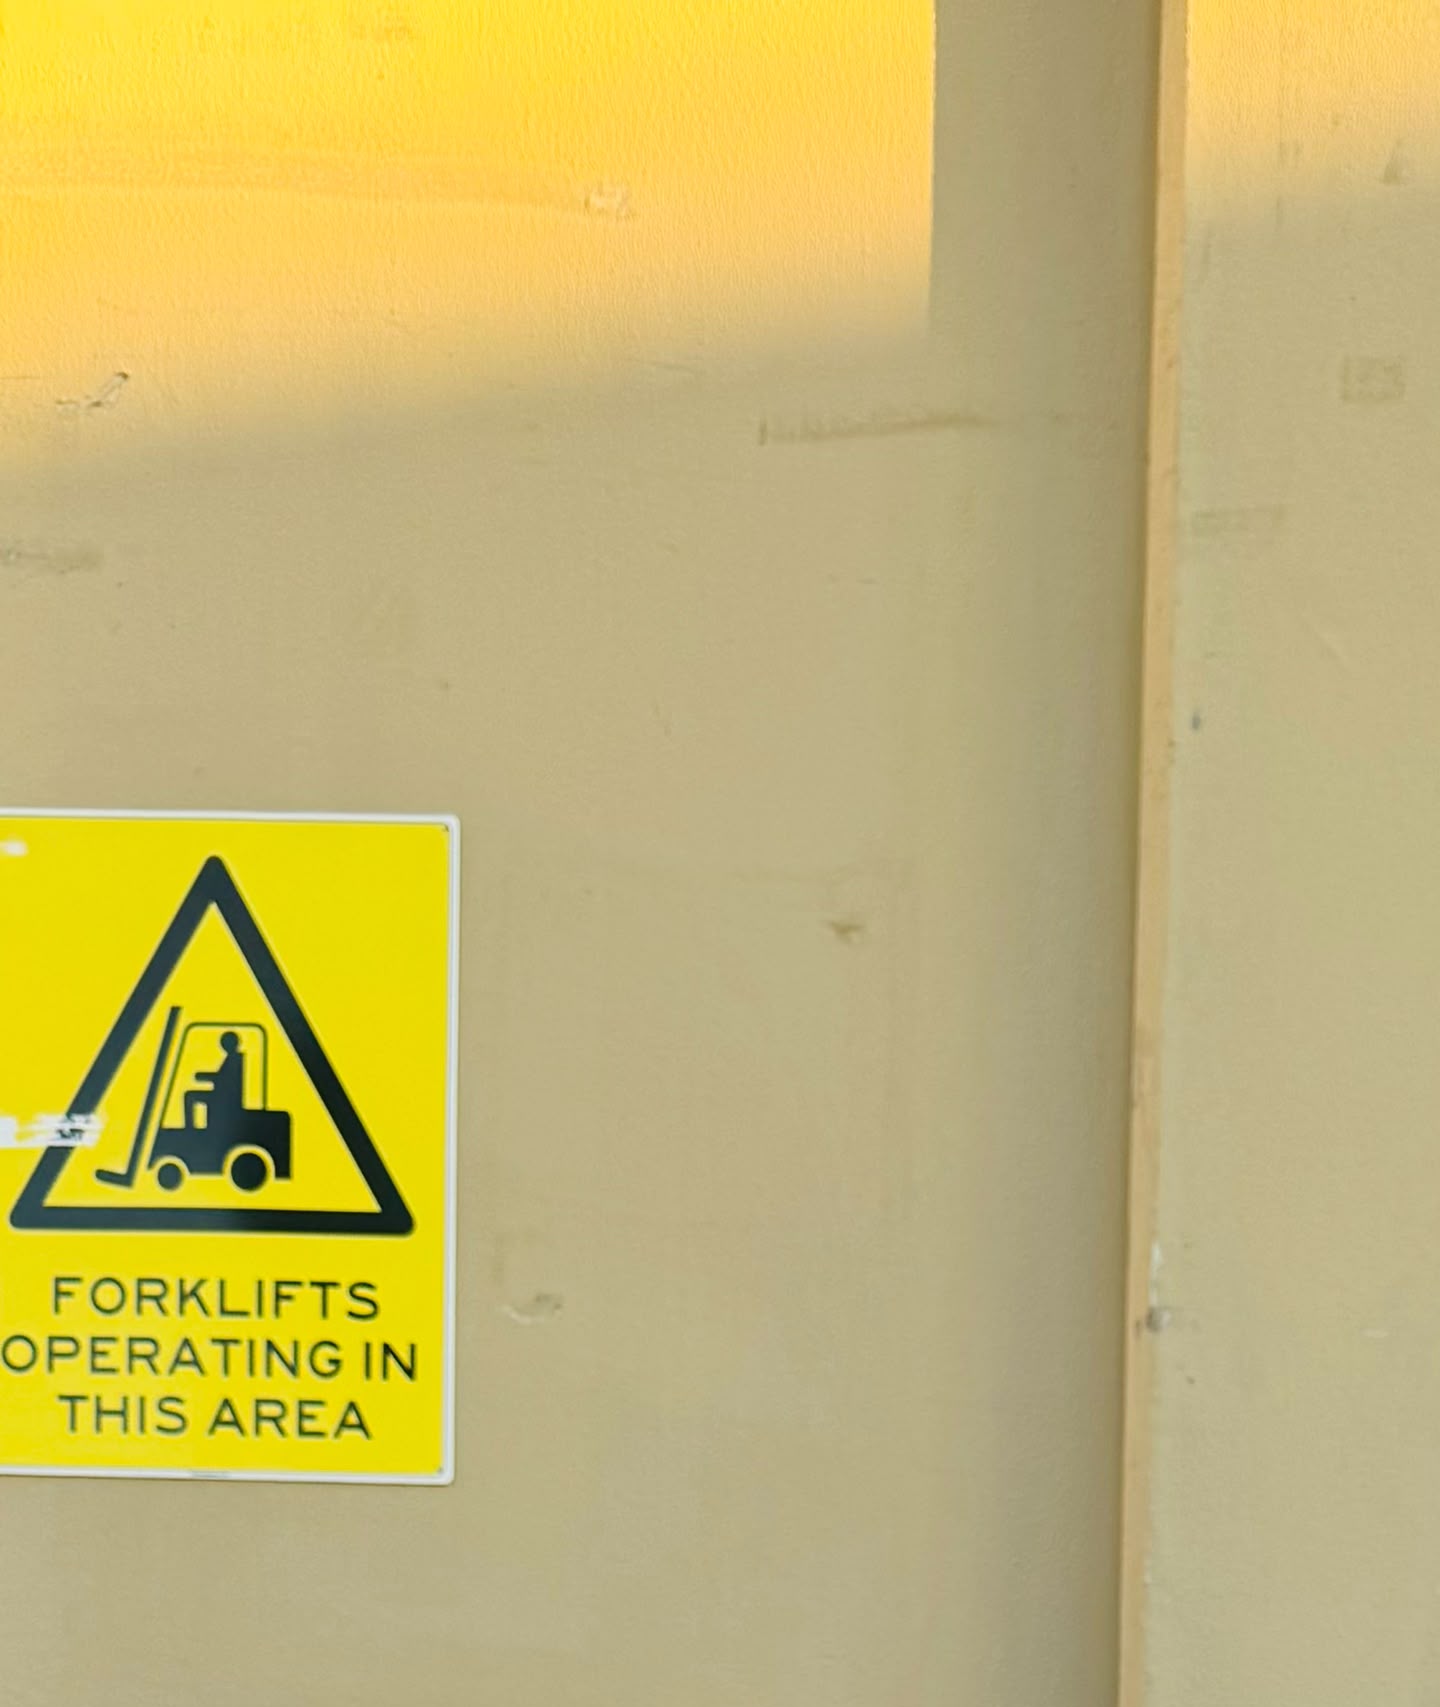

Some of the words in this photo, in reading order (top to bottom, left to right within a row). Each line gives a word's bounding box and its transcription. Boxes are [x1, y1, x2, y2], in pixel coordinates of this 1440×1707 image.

[53, 1276, 379, 1321] FORKLIFTS
[2, 1335, 340, 1379] OPERATING
[364, 1342, 416, 1381] IN
[58, 1395, 188, 1436] THIS
[207, 1398, 370, 1439] AREA
